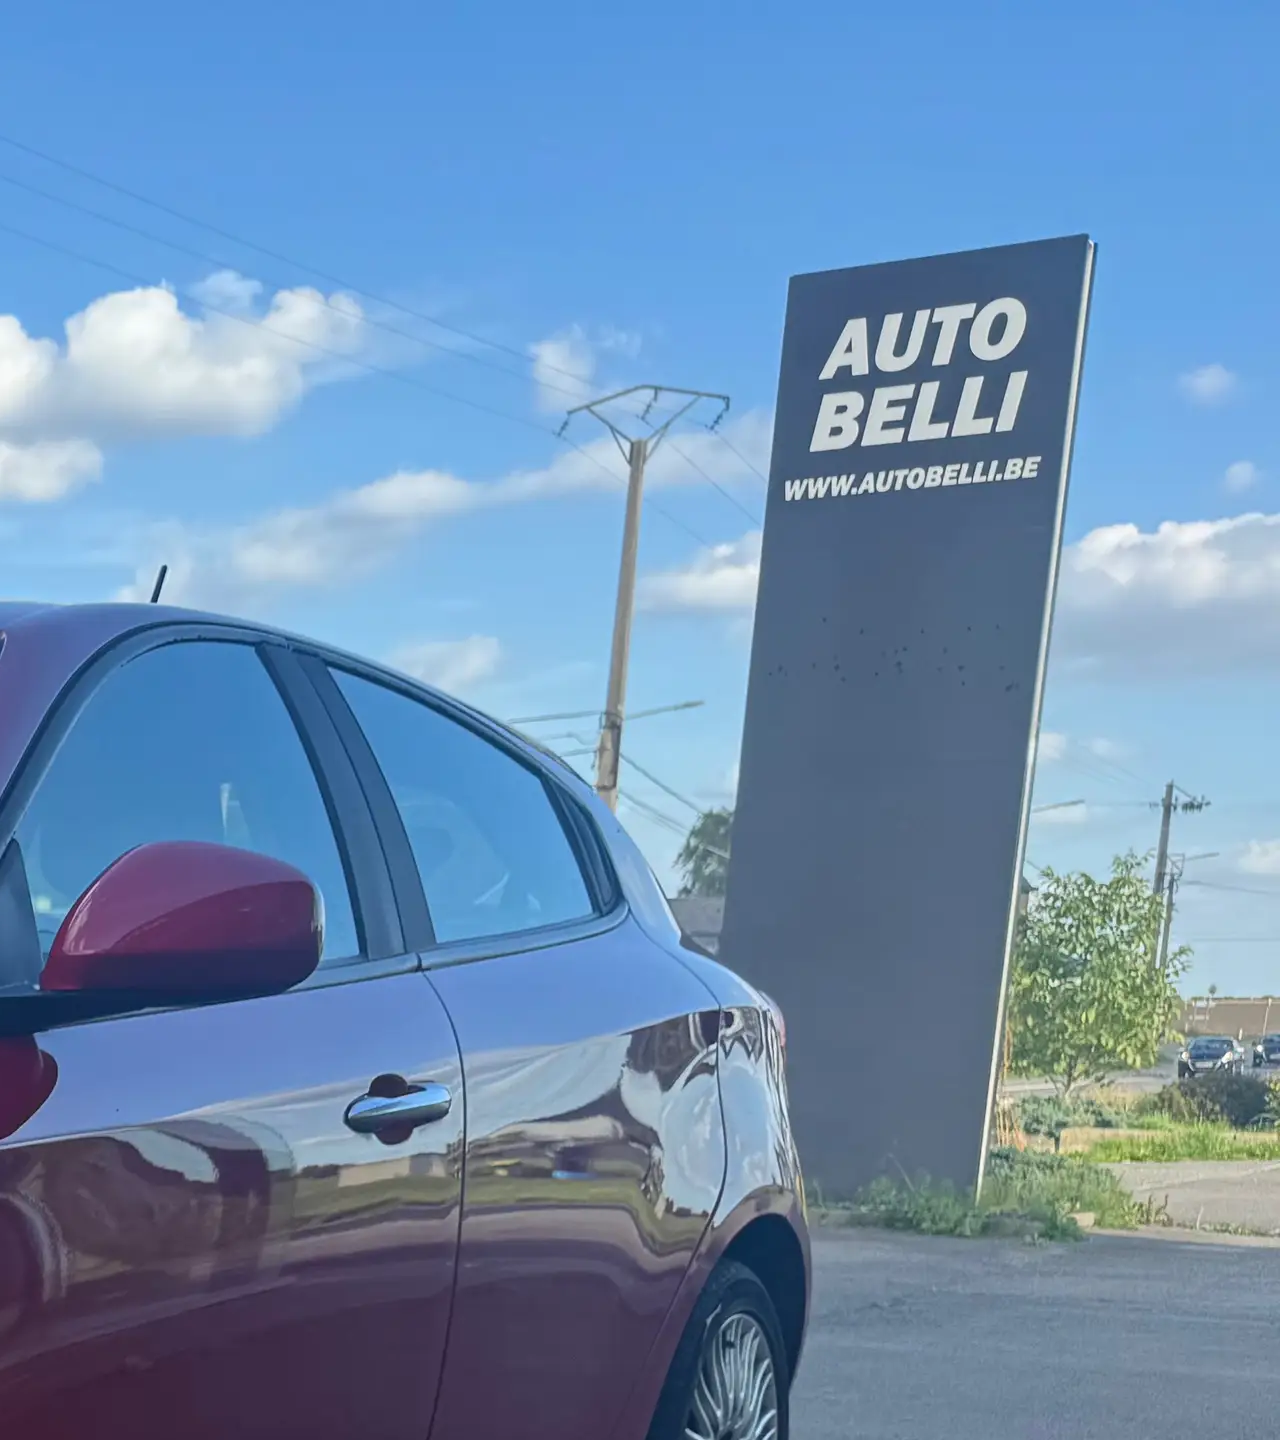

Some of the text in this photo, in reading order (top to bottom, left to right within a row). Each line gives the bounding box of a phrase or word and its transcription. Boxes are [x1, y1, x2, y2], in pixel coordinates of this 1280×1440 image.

[819, 297, 1027, 380] AUTO
[809, 370, 1028, 452] BELLI
[784, 456, 1042, 501] WWW.AUTOBELLI.BE
